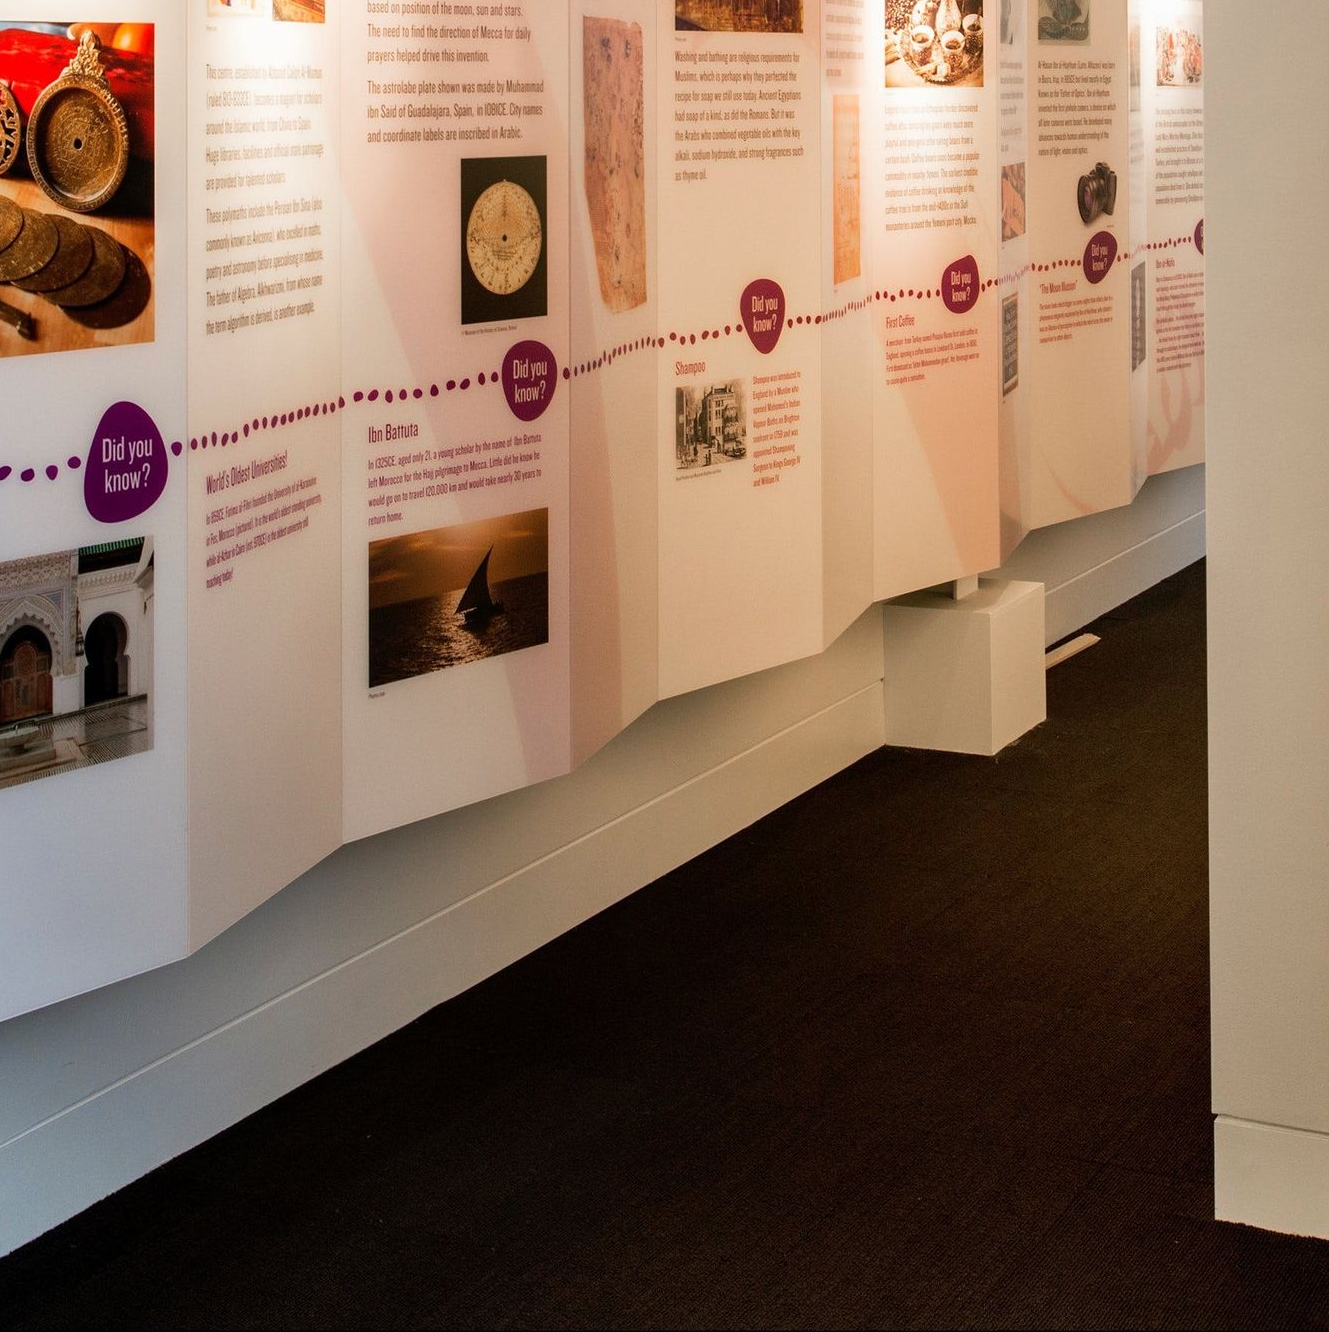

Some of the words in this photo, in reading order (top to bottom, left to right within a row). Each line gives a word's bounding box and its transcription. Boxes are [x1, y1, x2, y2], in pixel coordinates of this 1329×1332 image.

[367, 0, 388, 13] based
[391, 3, 400, 13] on
[402, 2, 430, 16] position
[432, 1, 439, 14] of
[441, 1, 451, 14] the
[477, 6, 488, 15] sun
[490, 4, 502, 16] and
[368, 22, 381, 37] The
[383, 24, 400, 37] need
[403, 27, 409, 37] to
[412, 24, 424, 37] find
[427, 25, 438, 38] the
[440, 25, 470, 38] direction
[472, 26, 479, 38] of
[481, 25, 502, 38] Mecca
[505, 26, 513, 38] for
[516, 27, 531, 42] daily
[367, 80, 381, 94] The
[383, 80, 416, 94] astrolabe
[418, 80, 436, 96] plate
[438, 80, 460, 93] shown
[462, 83, 475, 93] was
[477, 80, 495, 93] made
[497, 80, 504, 96] by
[506, 80, 543, 92] Muhammad
[367, 105, 378, 118] ibn
[381, 104, 396, 118] Said
[399, 104, 405, 118] of
[477, 105, 483, 116] in
[510, 102, 521, 118] City
[523, 106, 542, 115] names
[367, 129, 381, 142] and
[383, 128, 421, 142] coordinate
[423, 128, 444, 140] labels
[446, 130, 457, 140] are
[459, 127, 490, 140] inscribed
[492, 127, 498, 139] in
[951, 271, 960, 285] Did
[961, 272, 971, 287] you
[952, 287, 970, 302] know?
[752, 296, 764, 313] Did
[766, 297, 778, 316] you
[753, 314, 777, 333] know?
[886, 316, 898, 329] First
[899, 314, 914, 328] Coffee
[513, 358, 528, 379] Did
[531, 361, 547, 381] you
[675, 361, 706, 376] Shampoo
[515, 380, 546, 403] know?
[369, 426, 382, 443] Ibn
[386, 423, 418, 440] Battuta
[102, 436, 124, 463] Did
[129, 439, 152, 465] you
[105, 463, 150, 493] know?
[231, 466, 250, 486] Oldest
[379, 476, 403, 487] Morocco
[413, 471, 422, 480] the
[463, 464, 469, 472] to
[490, 457, 502, 468] Little
[513, 454, 518, 463] he
[520, 453, 532, 461] know
[534, 450, 540, 460] he
